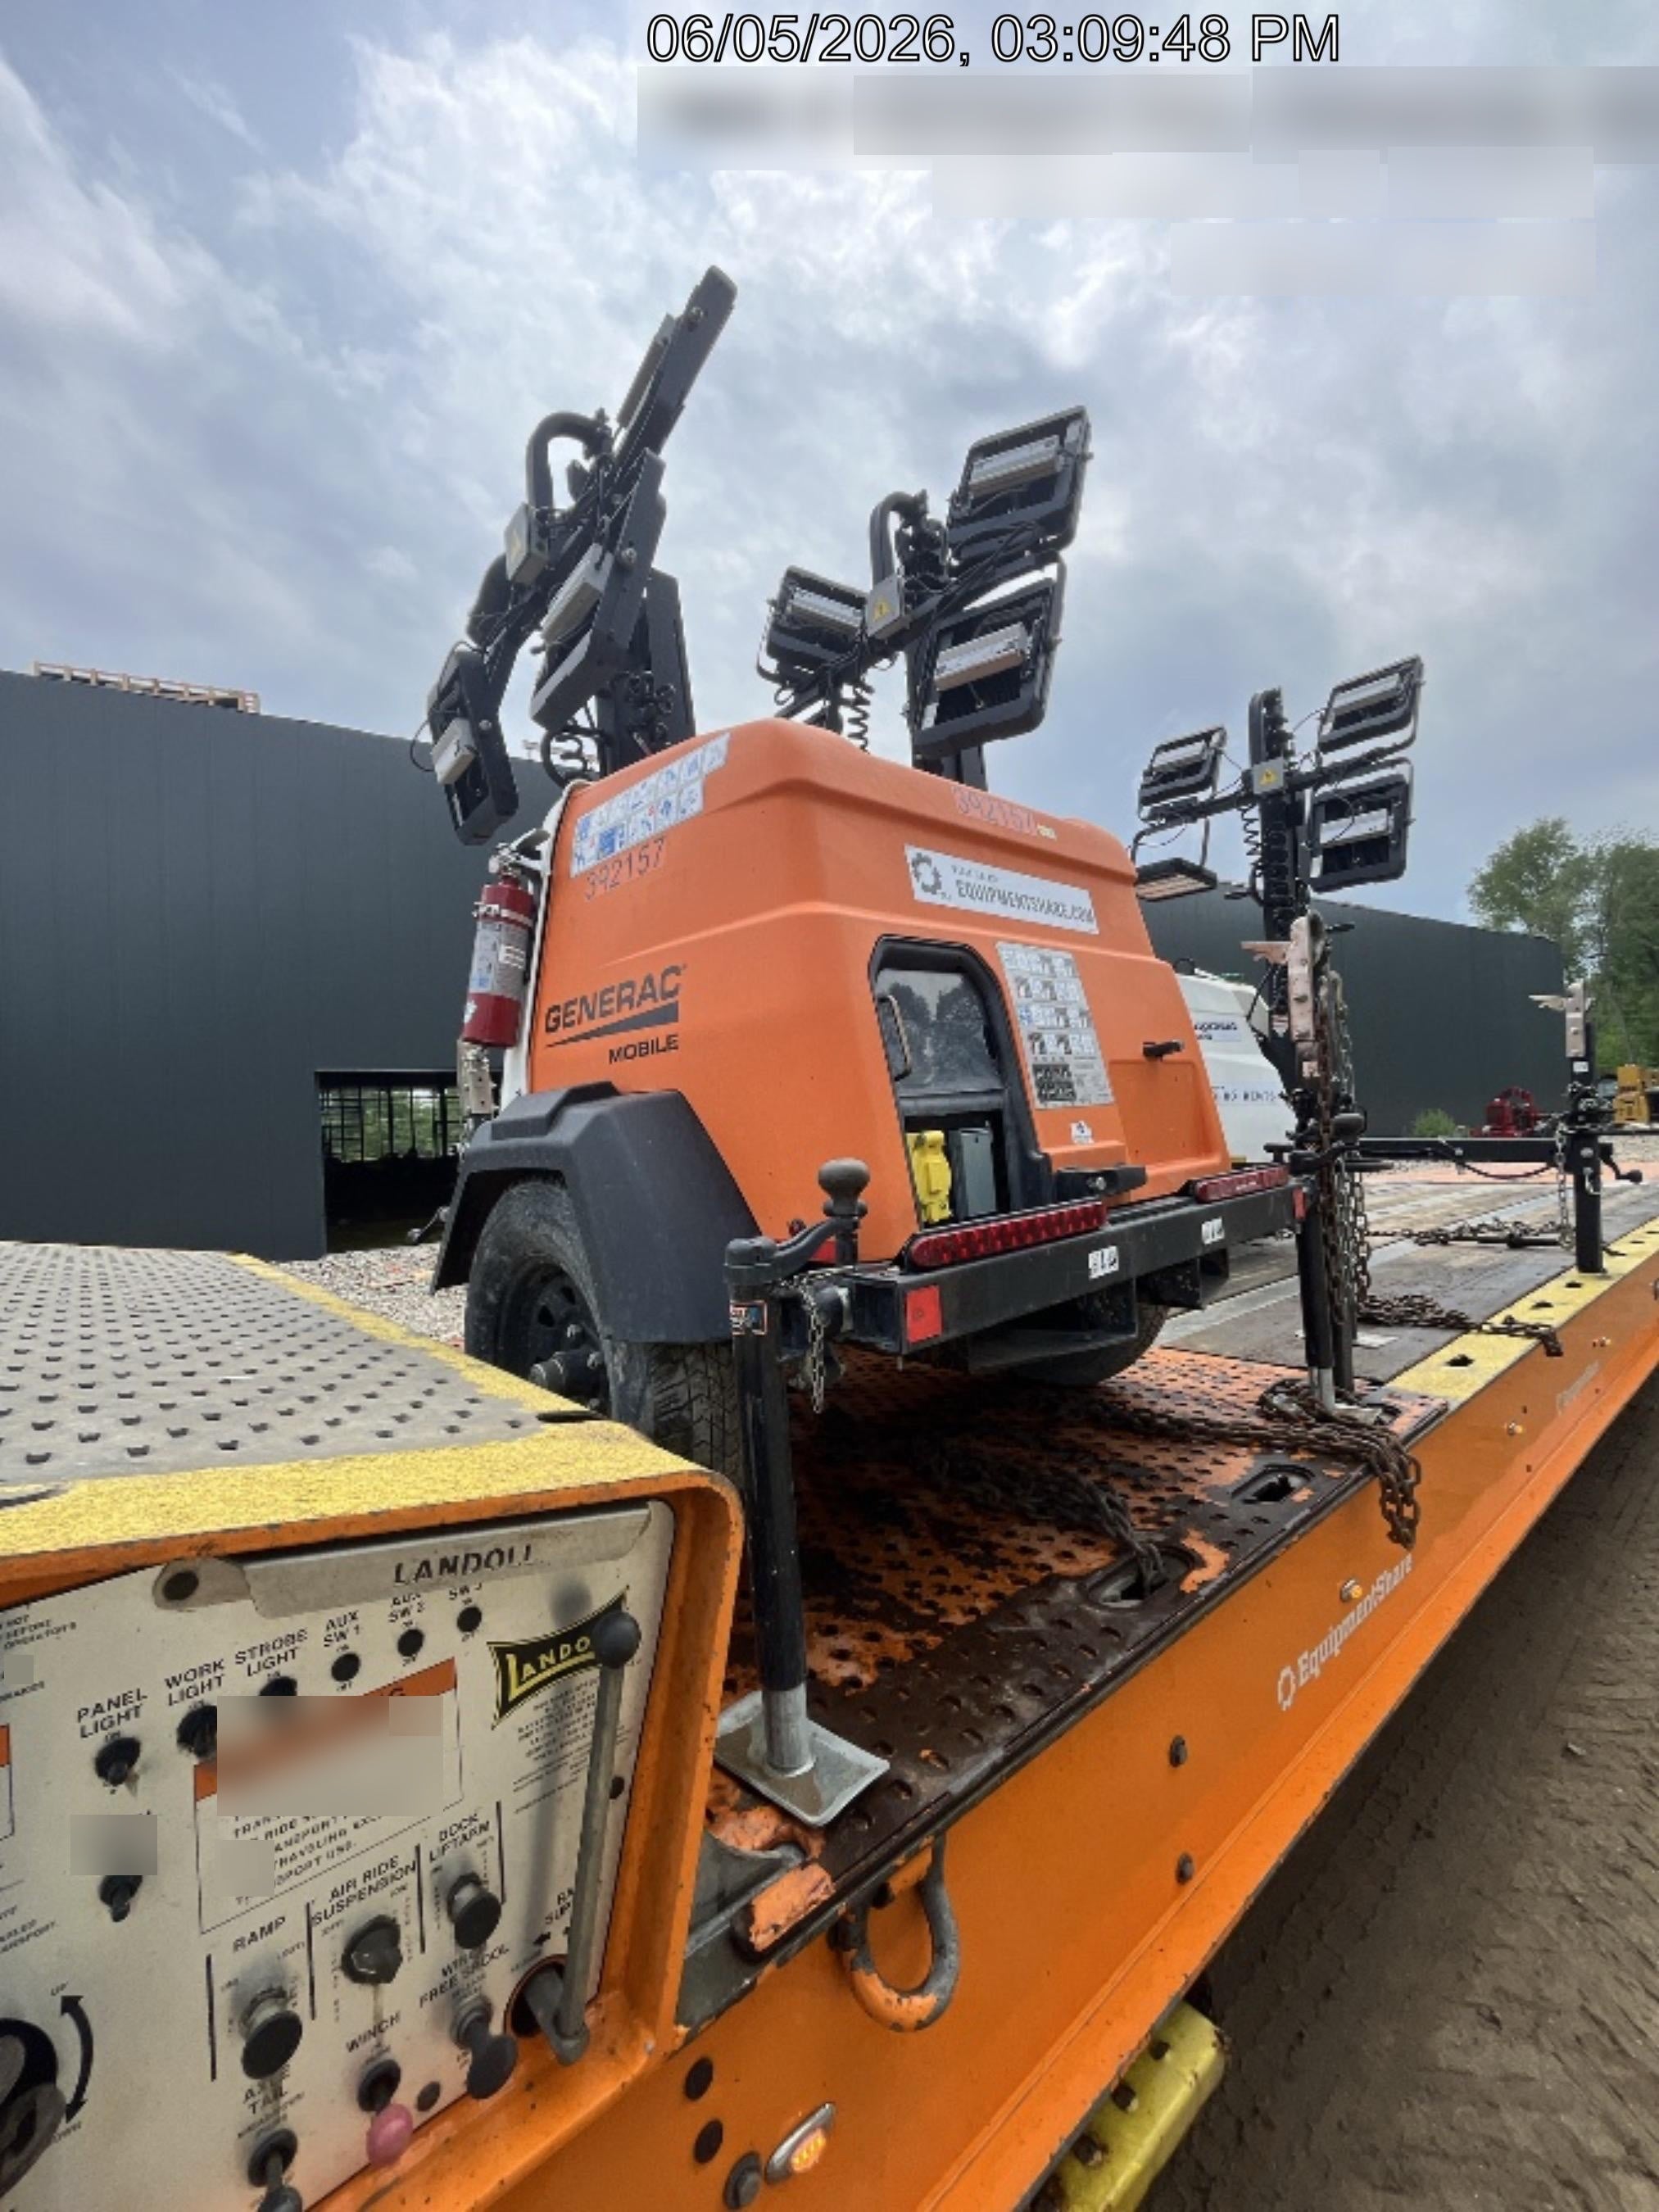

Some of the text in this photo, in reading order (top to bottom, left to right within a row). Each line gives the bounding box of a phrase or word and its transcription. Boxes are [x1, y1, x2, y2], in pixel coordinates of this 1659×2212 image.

[544, 965, 683, 1034] GENERAC
[608, 1035, 679, 1064] MOBILE
[324, 1610, 359, 1632] AUX
[1297, 1552, 1413, 1688] EquipmentShare
[234, 1629, 309, 1666] STROBE
[324, 1629, 349, 1648] SW
[165, 1658, 225, 1690] WORK
[247, 1647, 300, 1677] LIGHT
[505, 1636, 593, 1702] LANDO
[77, 1688, 148, 1724] PANEL
[168, 1674, 225, 1707] LIGHT
[79, 1703, 143, 1739] LIGHT
[311, 1861, 417, 1927] SUSPENSION
[330, 1878, 357, 1900] AIR
[363, 1855, 399, 1885] RIDE
[233, 1916, 286, 1954] RAMP
[345, 2011, 401, 2053] WINCH
